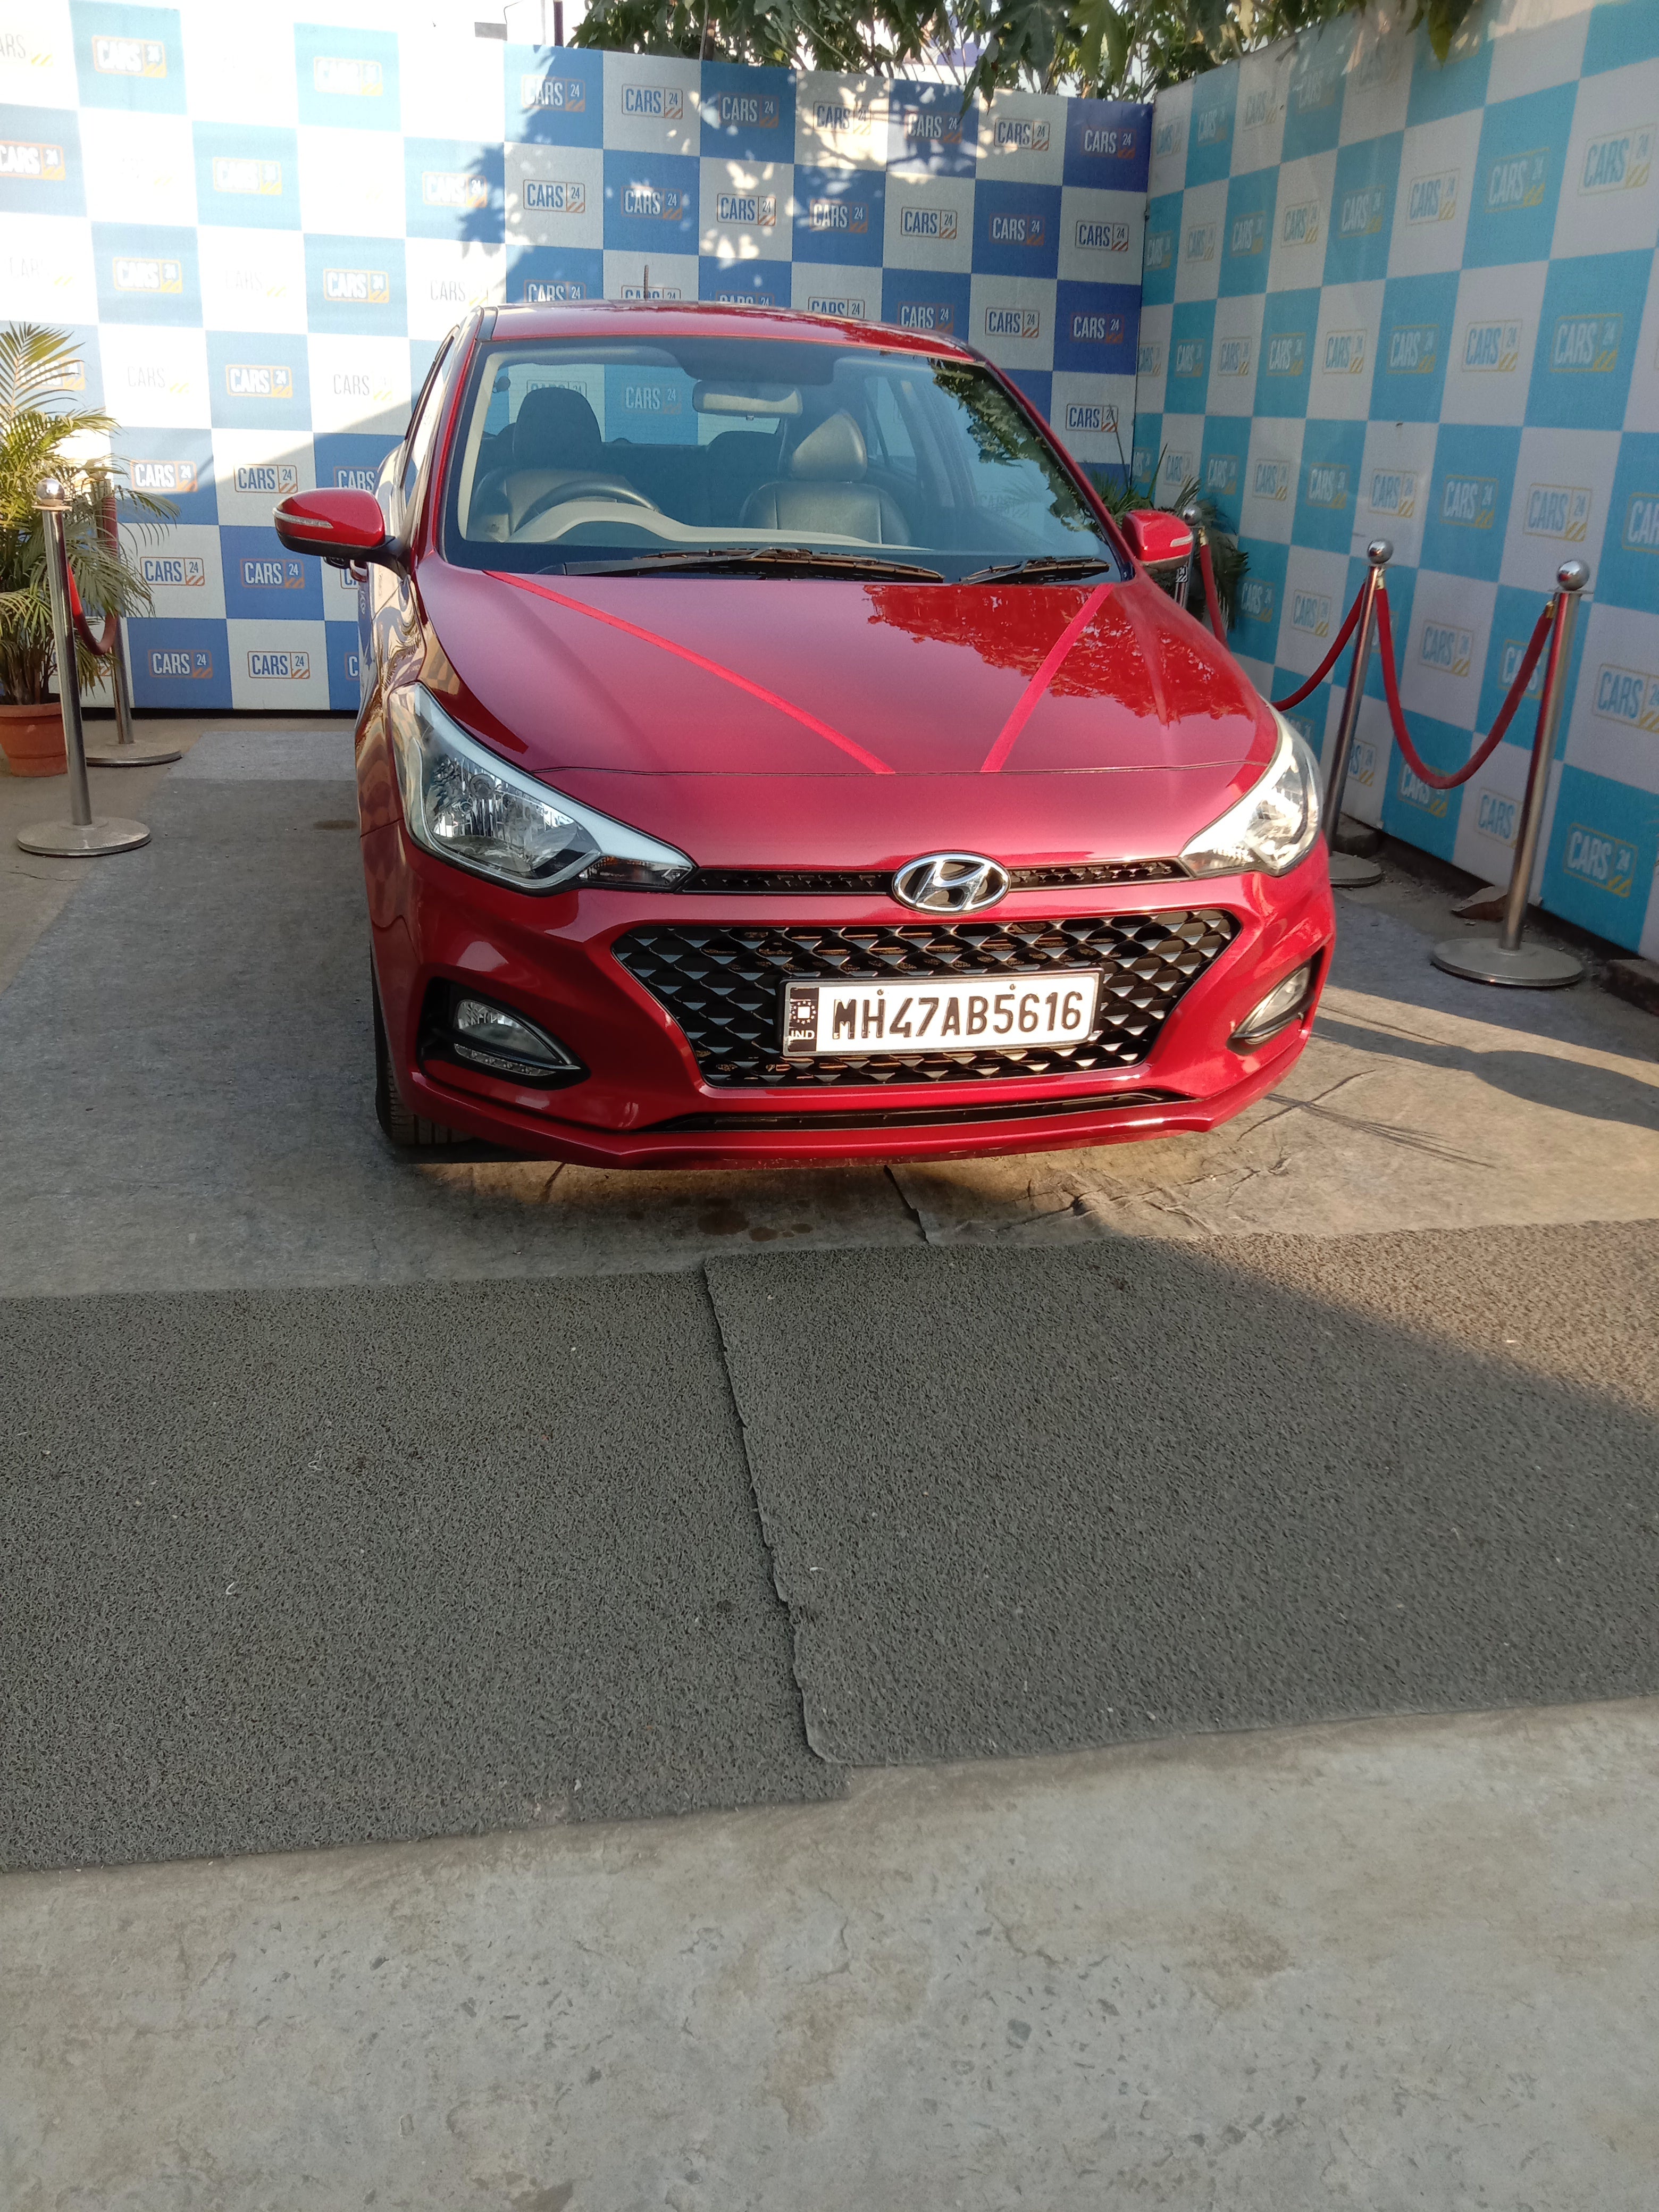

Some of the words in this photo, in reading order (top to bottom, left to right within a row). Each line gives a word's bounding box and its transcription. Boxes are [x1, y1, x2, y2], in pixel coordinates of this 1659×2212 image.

[97, 39, 143, 72] CARS
[524, 79, 563, 106] CARS
[571, 83, 580, 97] 24
[625, 88, 661, 114] CARS
[669, 93, 678, 105] 24
[722, 97, 758, 122] CARS
[765, 101, 774, 114] 24
[817, 105, 850, 129] CARS
[858, 109, 867, 122] 24
[906, 112, 942, 138] CARS
[949, 117, 957, 130] 24
[998, 121, 1030, 145] CARS
[1037, 124, 1045, 137] 24
[1084, 129, 1117, 154] CARS
[1122, 132, 1132, 146] 24
[1584, 137, 1630, 188] CARS
[1637, 132, 1650, 160] 24
[471, 179, 482, 194] 24
[1488, 159, 1528, 205] CARS
[527, 183, 564, 208] CARS
[571, 187, 580, 200] 24
[624, 190, 661, 215] CARS
[668, 192, 677, 207] 24
[1409, 178, 1441, 220] CARS
[720, 197, 756, 221] CARS
[763, 200, 772, 213] 24
[813, 203, 848, 228] CARS
[854, 207, 864, 220] 24
[1342, 194, 1370, 232] CARS
[904, 211, 937, 234] CARS
[944, 214, 953, 227] 24
[992, 216, 1025, 241] CARS
[1032, 220, 1040, 233] 24
[1079, 224, 1110, 246] CARS
[1116, 228, 1124, 239] 24
[1233, 219, 1253, 252] CARS
[1283, 207, 1308, 242] CARS
[116, 261, 159, 289] CARS
[327, 272, 367, 299] CARS
[372, 275, 384, 290] 24
[430, 279, 466, 302] CARS
[527, 283, 565, 302] CARS
[572, 286, 581, 299] 24
[852, 303, 860, 316] 24
[900, 305, 934, 329] CARS
[941, 308, 949, 321] 24
[988, 311, 1020, 333] CARS
[1027, 314, 1035, 325] 24
[1073, 316, 1105, 339] CARS
[1110, 319, 1119, 331] 24
[1268, 339, 1293, 371] CARS
[1325, 335, 1352, 368] CARS
[1389, 330, 1422, 368] CARS
[1465, 327, 1502, 365] CARS
[1554, 321, 1597, 364] CARS
[1603, 321, 1617, 346] 24
[1176, 344, 1195, 372] CARS
[1220, 341, 1241, 371] CARS
[128, 366, 165, 388] CARS
[230, 368, 270, 395] CARS
[275, 370, 287, 386] 24
[333, 374, 370, 396] CARS
[625, 386, 661, 410] CARS
[667, 388, 677, 401] 24
[1069, 407, 1100, 428] CARS
[135, 463, 174, 488] CARS
[181, 465, 192, 479] 24
[237, 467, 275, 490] CARS
[282, 469, 292, 481] 24
[338, 470, 376, 490] CARS
[1166, 455, 1183, 481] CARS
[1207, 458, 1228, 490] CARS
[1255, 463, 1277, 495] CARS
[1309, 467, 1336, 501] CARS
[1371, 474, 1402, 509] CARS
[1443, 480, 1478, 521] CARS
[1481, 484, 1495, 506] 24
[1528, 490, 1569, 531] CARS
[1573, 495, 1587, 517] 24
[144, 560, 182, 583] CARS
[189, 561, 199, 574] 24
[245, 561, 283, 585] CARS
[289, 563, 299, 575] 24
[1293, 595, 1318, 629] CARS
[1421, 626, 1455, 666] CARS
[152, 652, 191, 675] CARS
[197, 653, 207, 666] 24
[252, 655, 288, 675] CARS
[295, 656, 304, 667] 24
[1598, 671, 1643, 719] CARS
[1478, 794, 1514, 840] CARS
[1568, 831, 1612, 881] CARS
[1616, 848, 1631, 873] 24
[832, 991, 1083, 1040] MH47AB5616
[790, 1030, 815, 1040] IND
